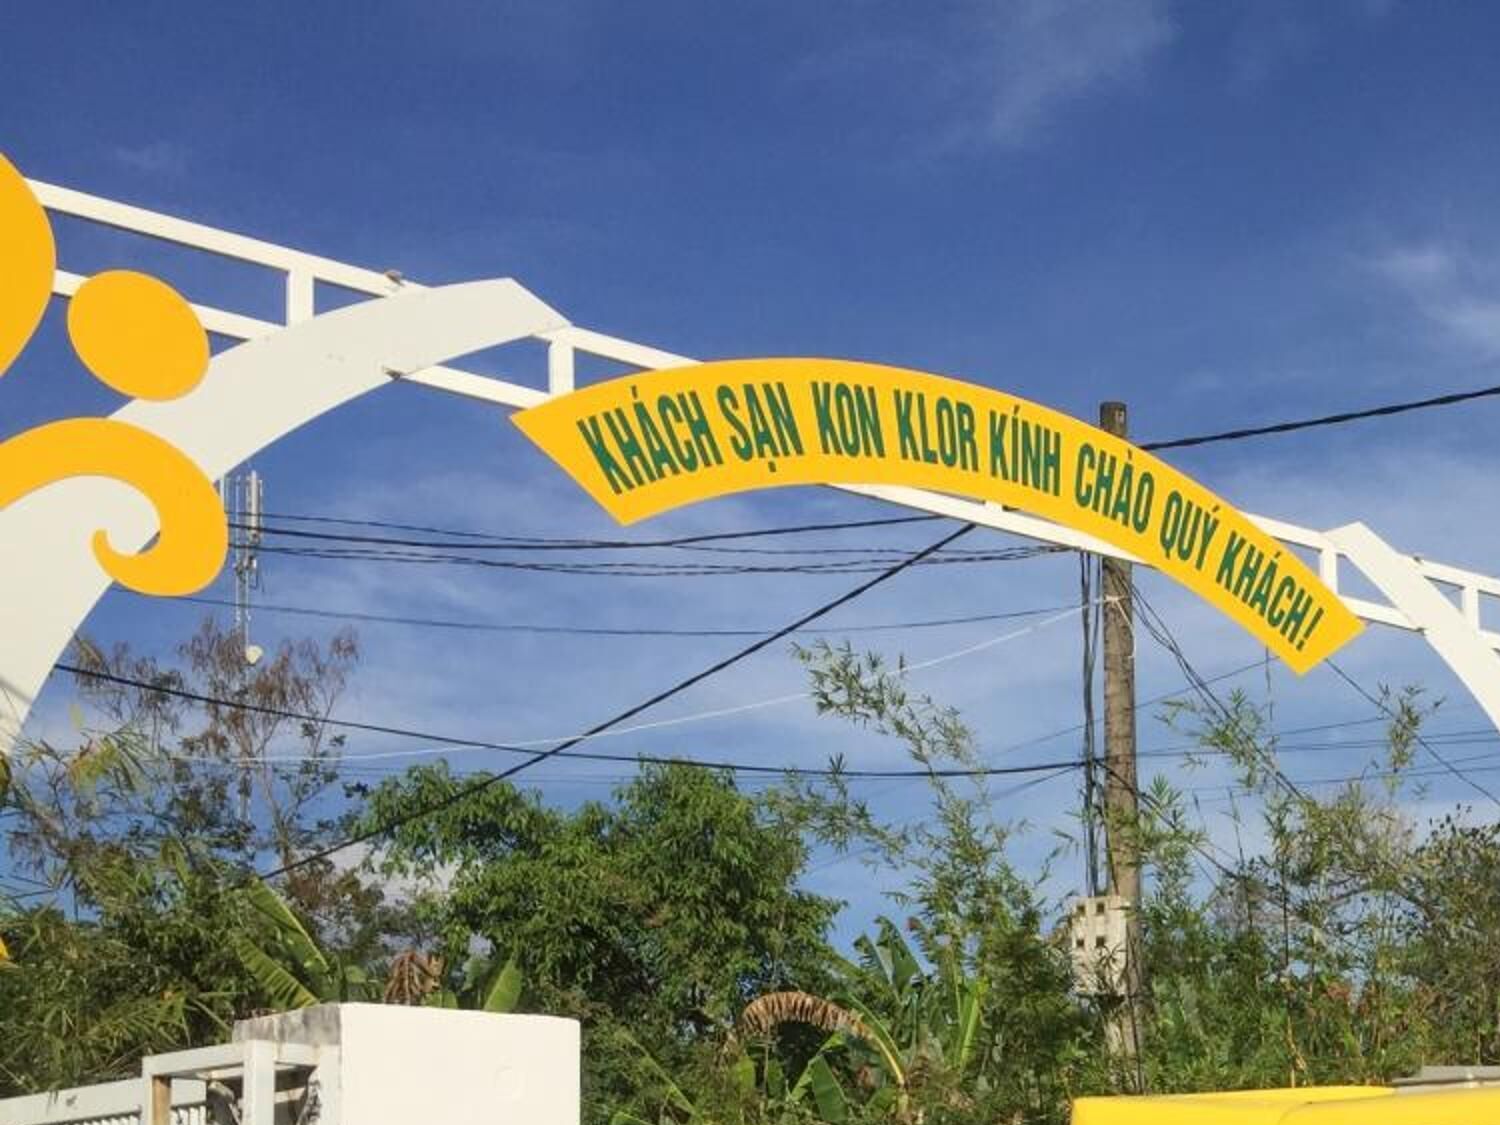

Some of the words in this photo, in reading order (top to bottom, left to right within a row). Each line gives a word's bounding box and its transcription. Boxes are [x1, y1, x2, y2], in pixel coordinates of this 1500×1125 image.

[576, 385, 723, 494] KHÁCH
[717, 381, 803, 473] SẠN
[812, 382, 886, 459] KON
[895, 390, 979, 473] KLOR
[989, 405, 1062, 497] KÍNH
[1074, 443, 1155, 534] CHÀO
[1159, 490, 1221, 571] QUÝ
[1215, 530, 1325, 651] KHÁCH!
